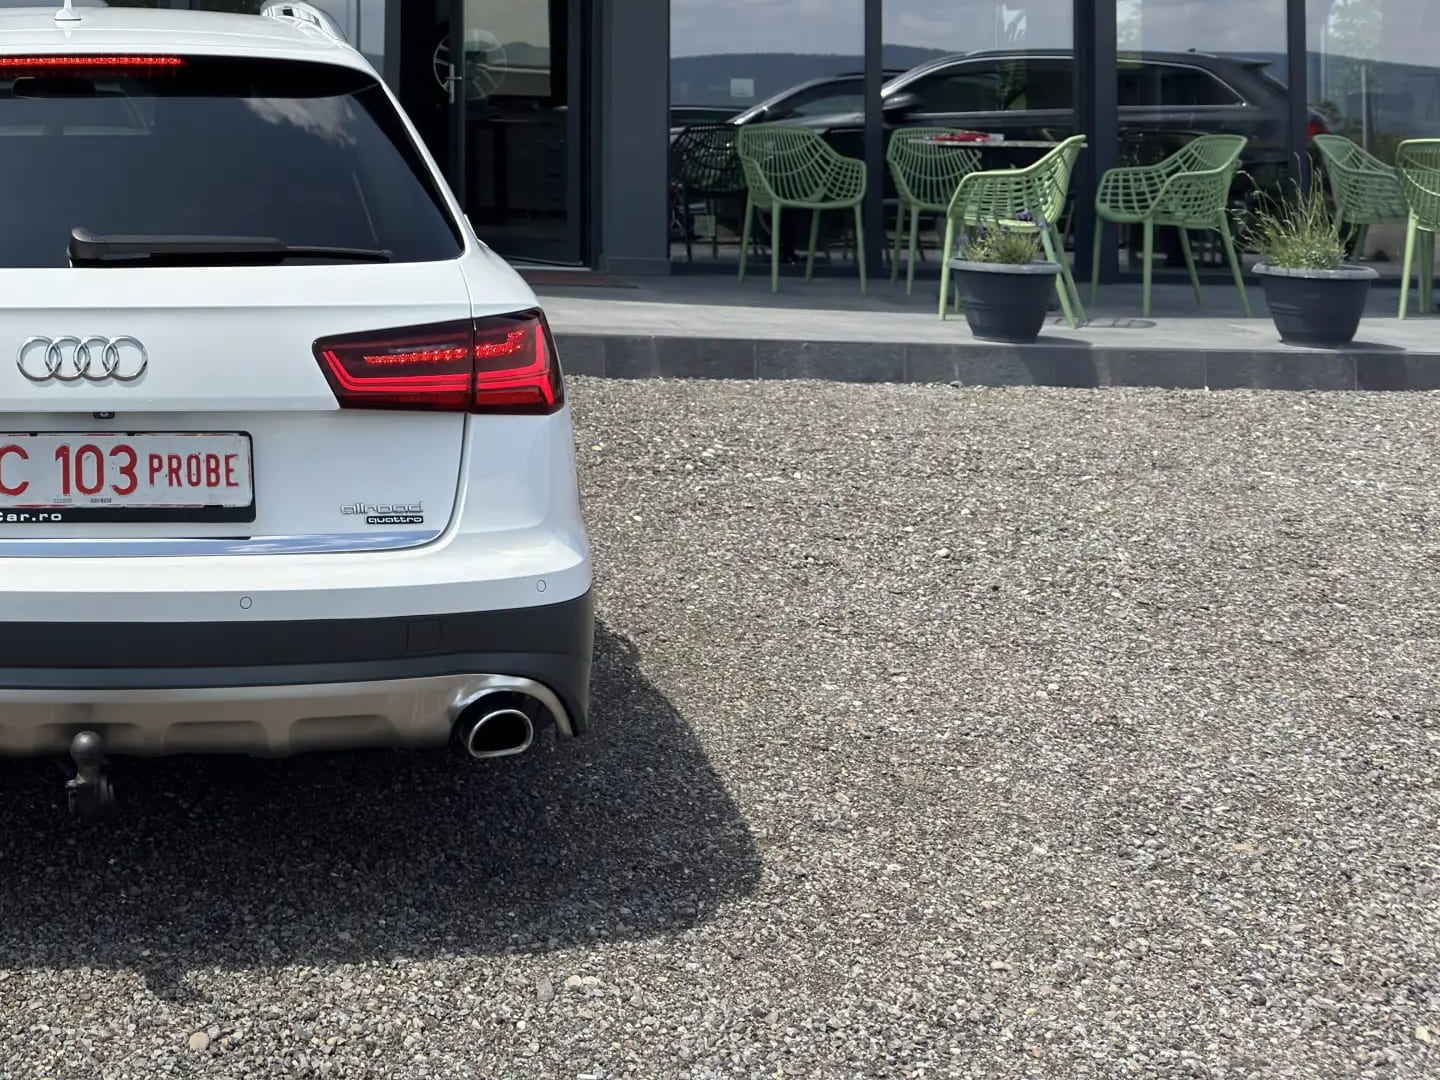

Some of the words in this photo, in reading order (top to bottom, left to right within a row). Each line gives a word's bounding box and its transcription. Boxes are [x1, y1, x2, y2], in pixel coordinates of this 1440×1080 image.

[54, 443, 139, 497] 103
[148, 452, 240, 488] PROBE
[341, 500, 424, 515] allroad
[367, 516, 423, 525] quattro
